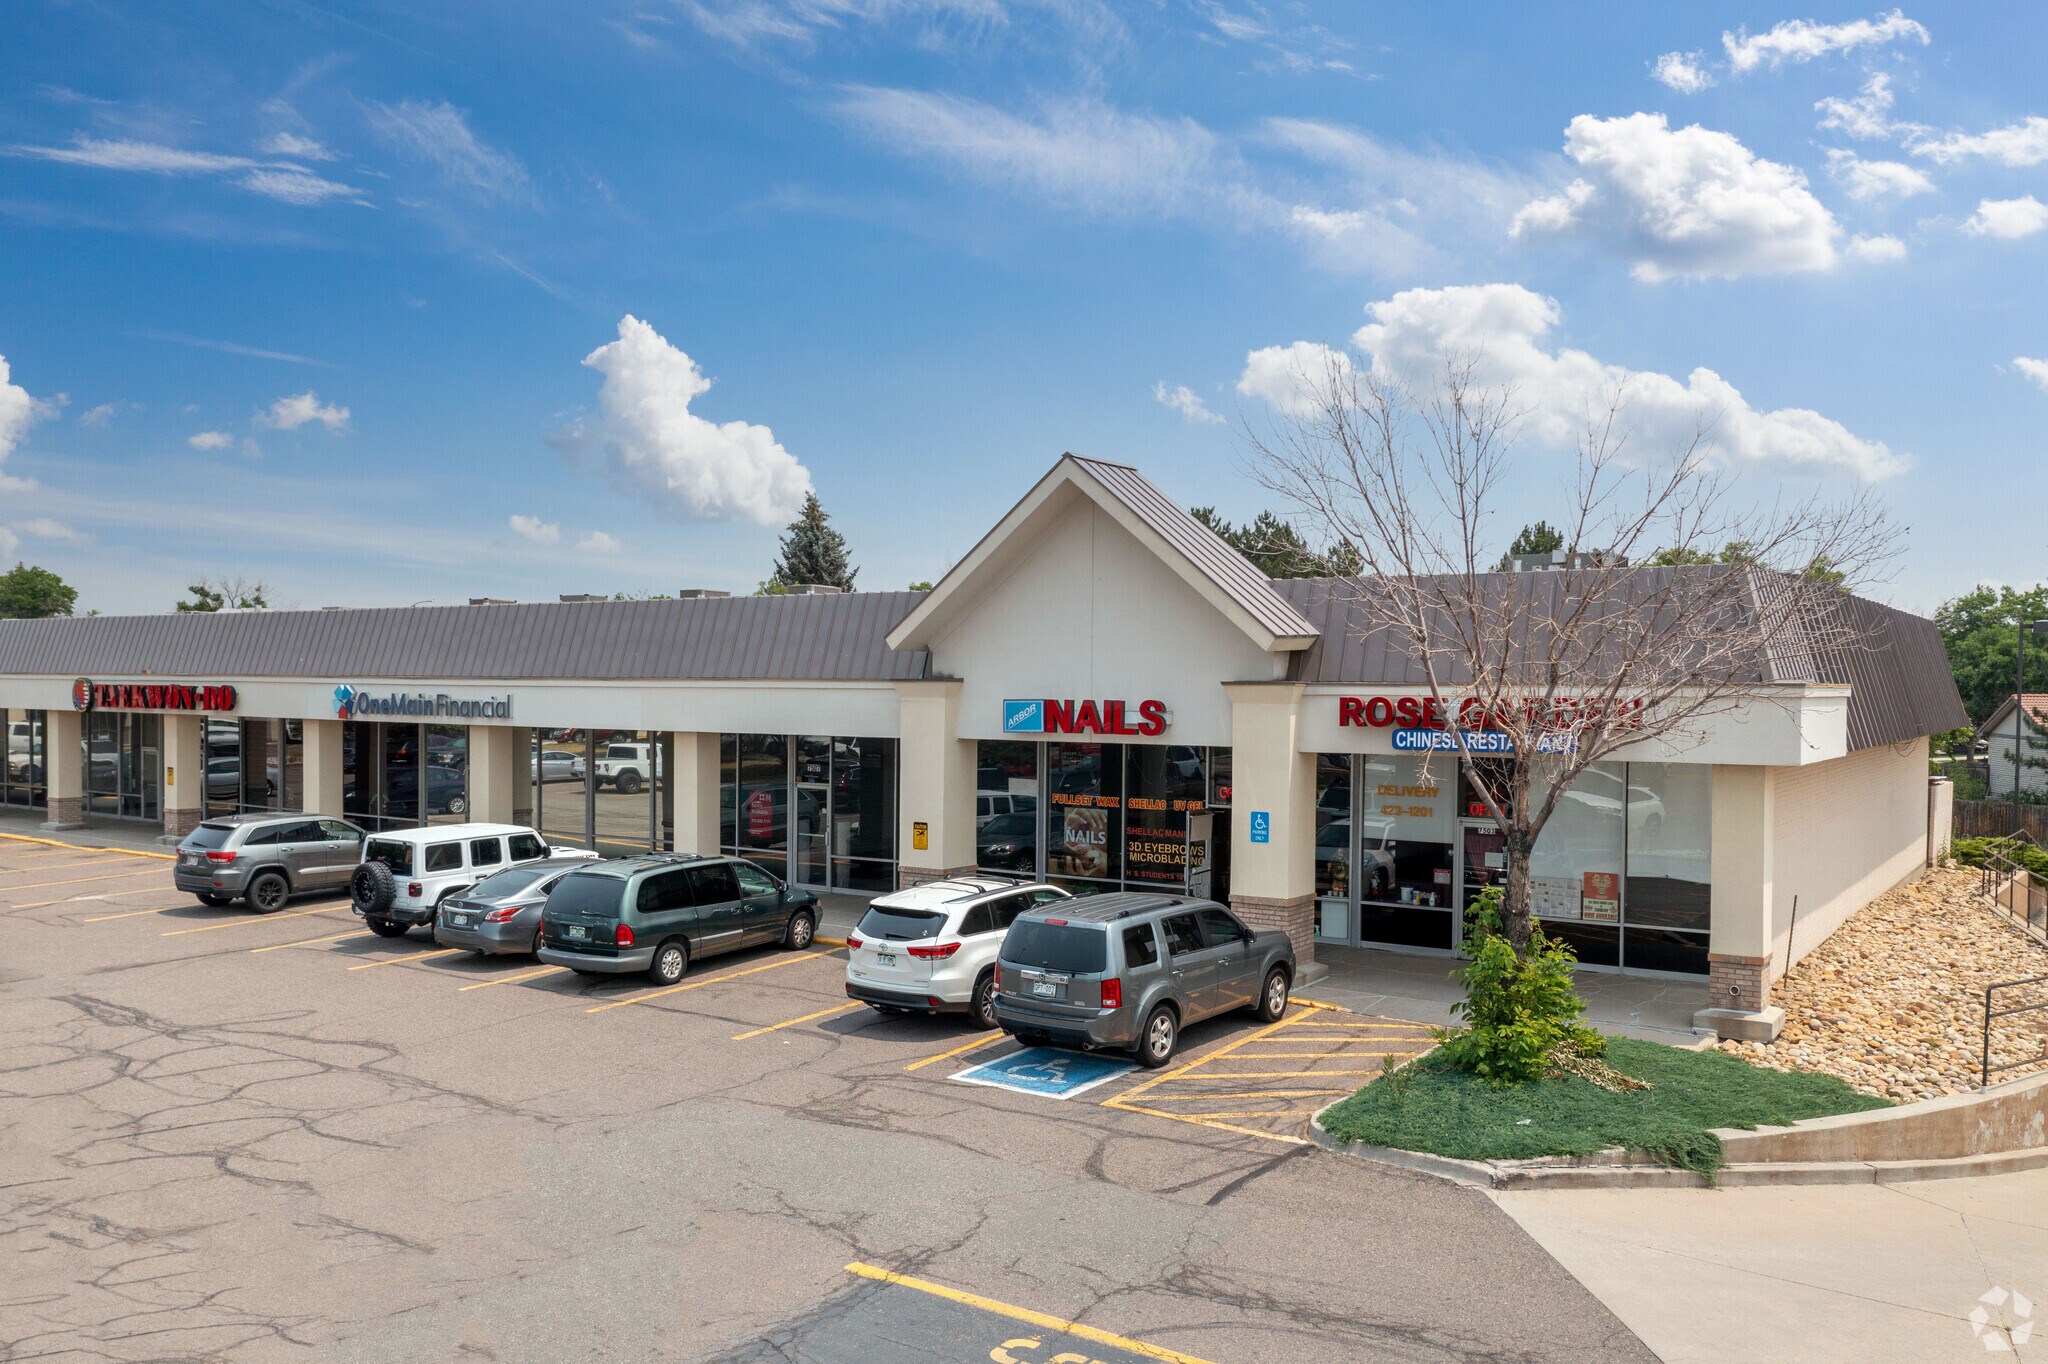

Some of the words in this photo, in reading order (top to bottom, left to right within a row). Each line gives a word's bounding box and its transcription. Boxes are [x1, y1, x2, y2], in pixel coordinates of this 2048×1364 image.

[94, 684, 237, 711] TAEKWON-DO
[1008, 703, 1036, 727] ARBOR
[1044, 699, 1167, 736] NAILS
[1339, 697, 1449, 729] ROSE
[1377, 784, 1440, 799] DELIVERY
[1051, 793, 1093, 806] FULLSET
[1095, 795, 1120, 808] WAX
[1128, 798, 1167, 810] SHELLAC
[1173, 799, 1187, 811] UV
[1380, 804, 1434, 818] 423-1201
[1469, 803, 1506, 817] OPN
[1065, 829, 1106, 845] NAILS
[1126, 827, 1164, 836] SHELLAC
[1128, 841, 1142, 853] 3D
[1129, 852, 1206, 866] MICROBLADNG
[1141, 871, 1175, 880] STUDENTS
